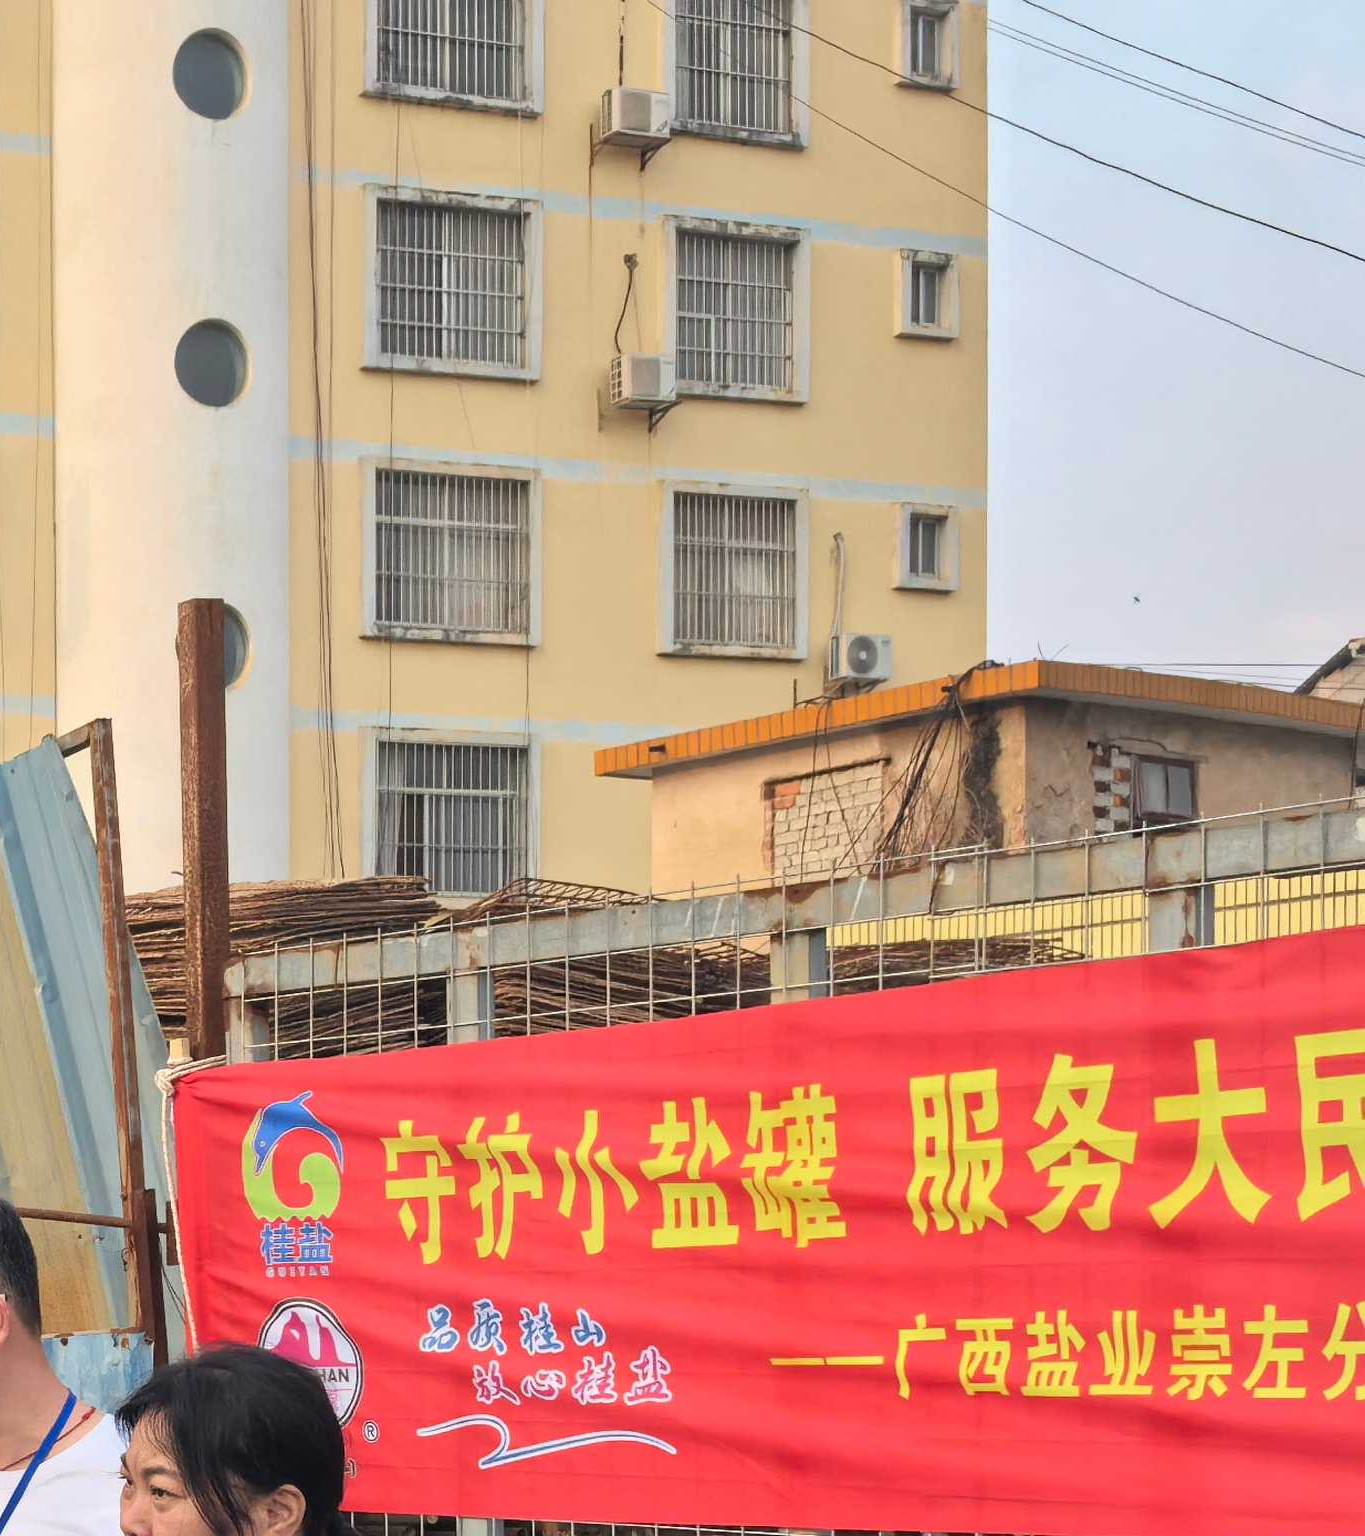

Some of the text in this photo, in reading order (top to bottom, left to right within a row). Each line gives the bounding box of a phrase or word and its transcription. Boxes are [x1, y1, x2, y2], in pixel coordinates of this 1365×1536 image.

[380, 1028, 1365, 1265] 守护小盐罐 服务大民
[260, 1222, 334, 1267] 桂盐
[420, 1297, 606, 1357] 品质桂山
[472, 1345, 673, 1408] 放心桂盐
